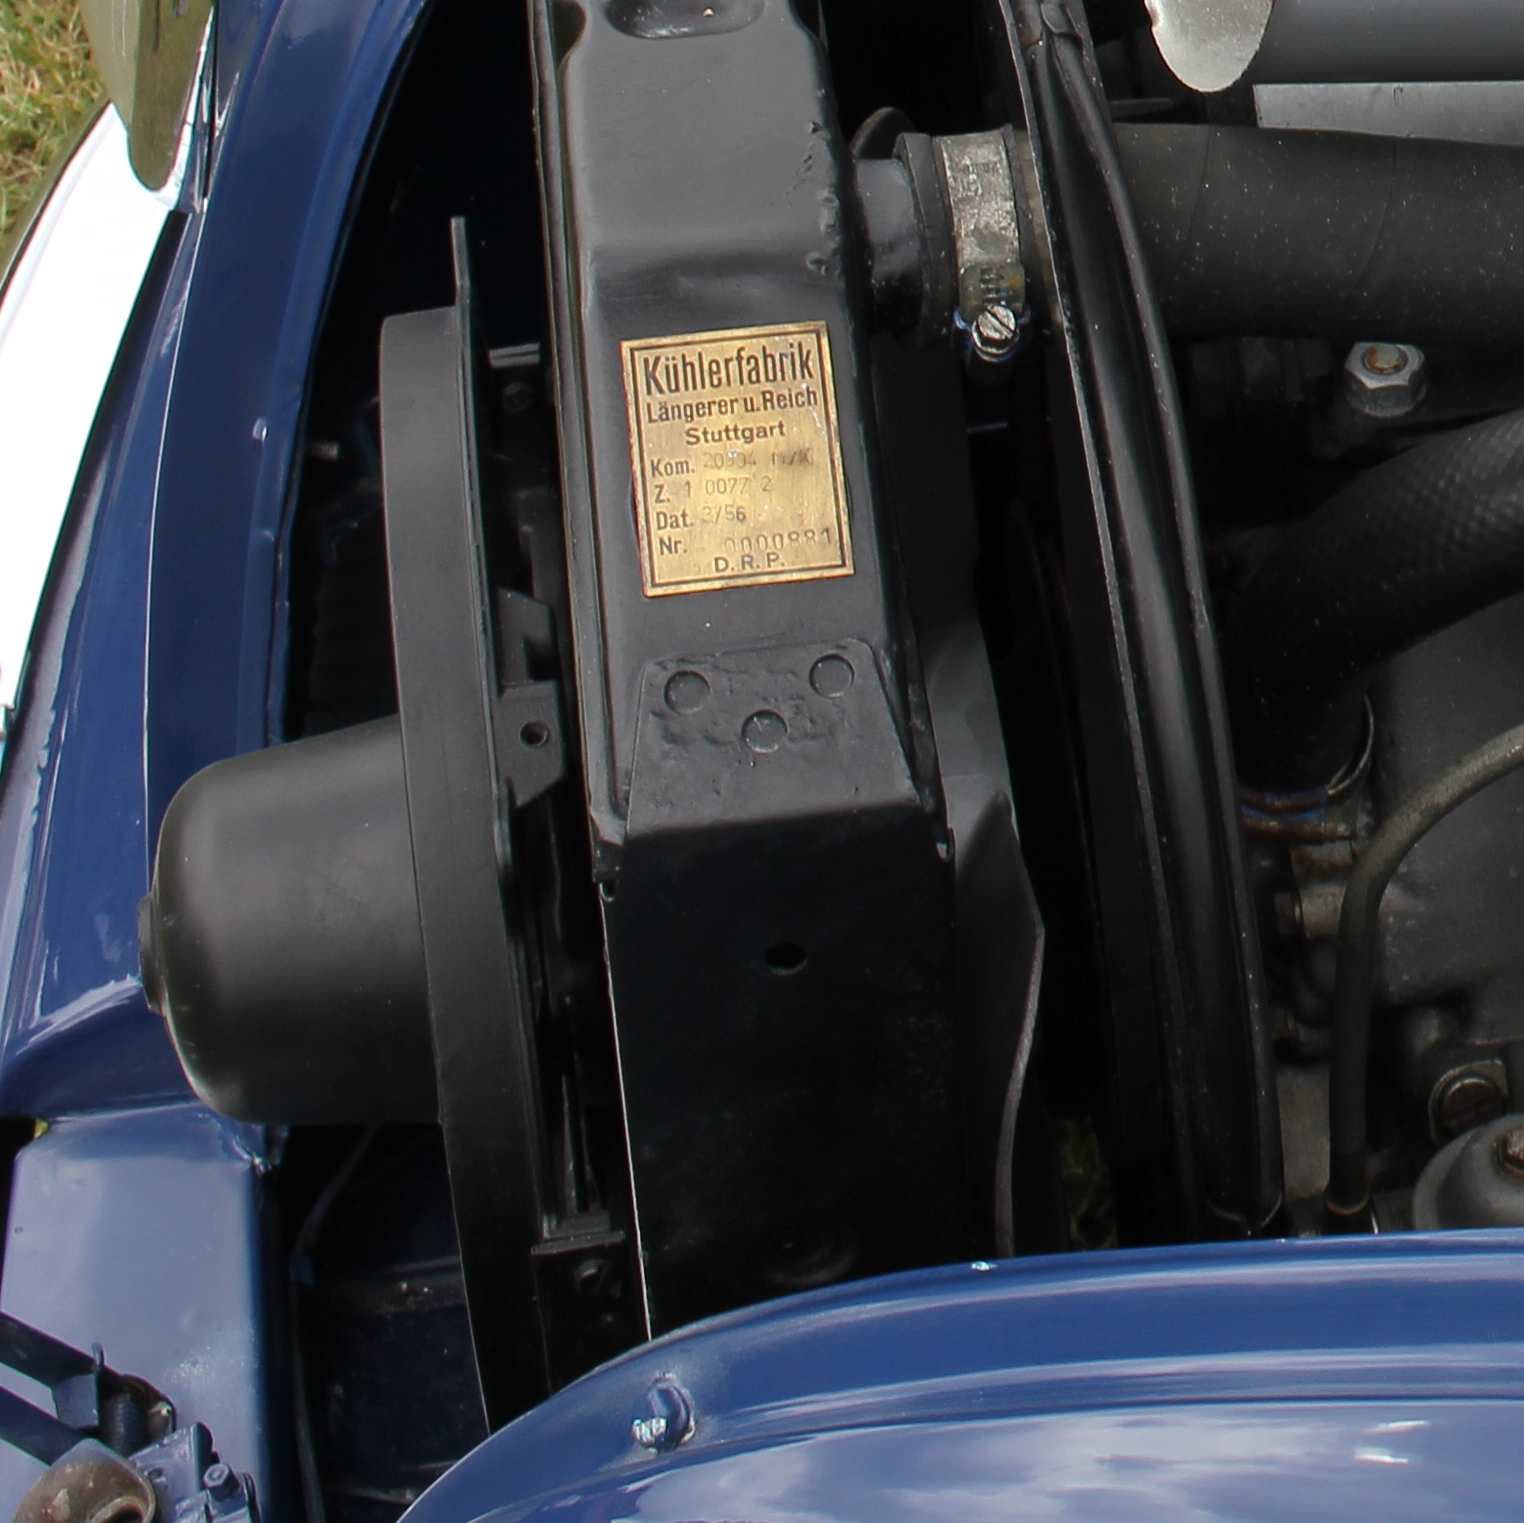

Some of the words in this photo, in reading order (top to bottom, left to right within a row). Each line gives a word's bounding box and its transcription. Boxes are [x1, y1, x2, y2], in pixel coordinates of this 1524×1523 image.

[643, 341, 814, 396] Kühlerfabrik
[646, 397, 739, 424] Längerer
[685, 420, 786, 446] Stuttgart
[650, 458, 696, 479] Kom.
[653, 483, 671, 504] Z.
[656, 508, 694, 531] Dat.
[659, 535, 688, 556] Nr.
